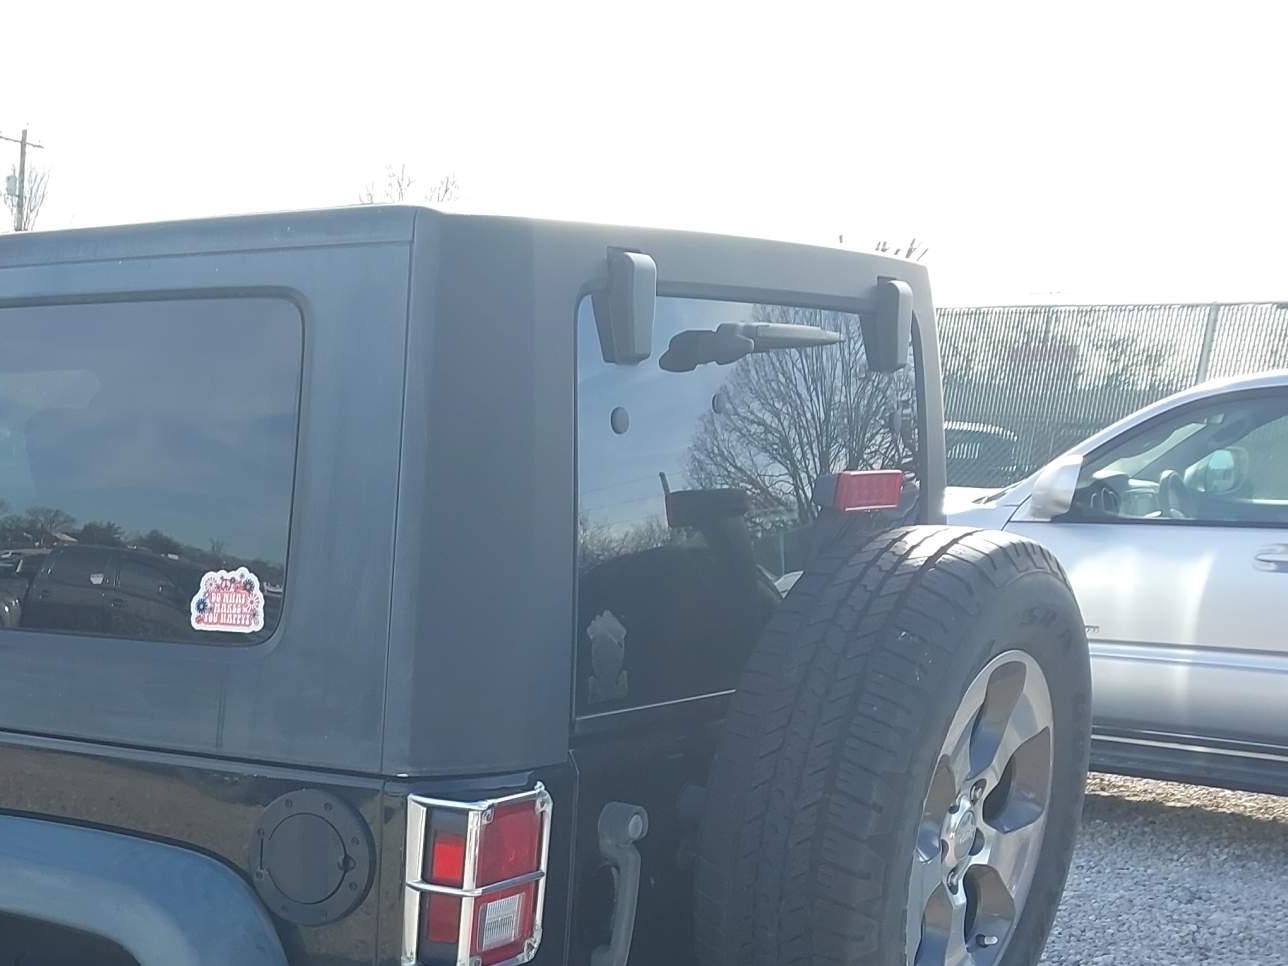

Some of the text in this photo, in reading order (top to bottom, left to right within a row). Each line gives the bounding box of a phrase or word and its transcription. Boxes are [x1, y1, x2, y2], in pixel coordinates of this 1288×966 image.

[211, 592, 246, 604] DO WHAT
[213, 603, 241, 613] MAKES
[203, 613, 218, 623] YOU
